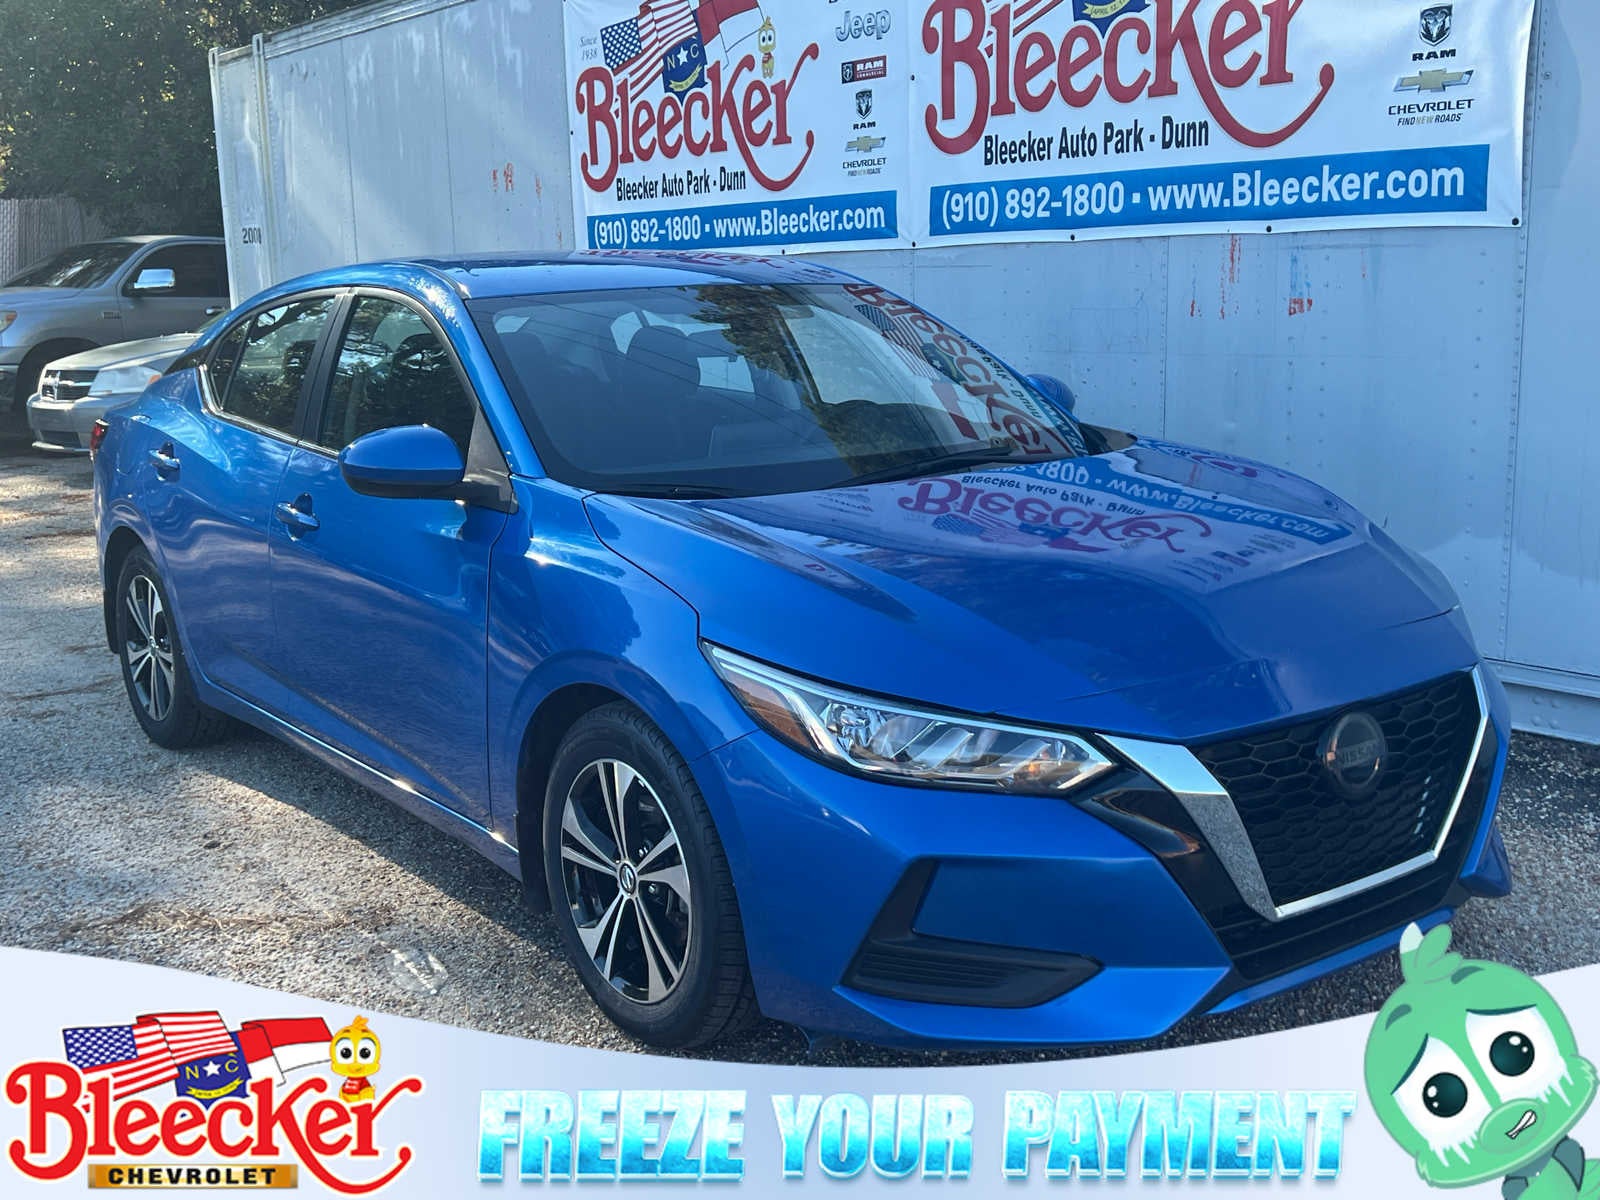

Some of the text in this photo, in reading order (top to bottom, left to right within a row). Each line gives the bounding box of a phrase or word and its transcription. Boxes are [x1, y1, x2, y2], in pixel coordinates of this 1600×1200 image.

[835, 10, 891, 41] Jeep
[1412, 49, 1456, 61] RAM
[1388, 98, 1475, 115] CHEVROLET
[853, 121, 876, 130] RAM
[984, 116, 1209, 166] Bleecker Auto Park Dunn
[842, 157, 886, 169] CHEVROLET
[616, 166, 746, 201] Bleecker Auto Park Dunn
[943, 165, 1465, 230] (910) 892-1800 www.Bleecker.com
[594, 204, 886, 249] (910) 892-1800 www.Bleecker.com
